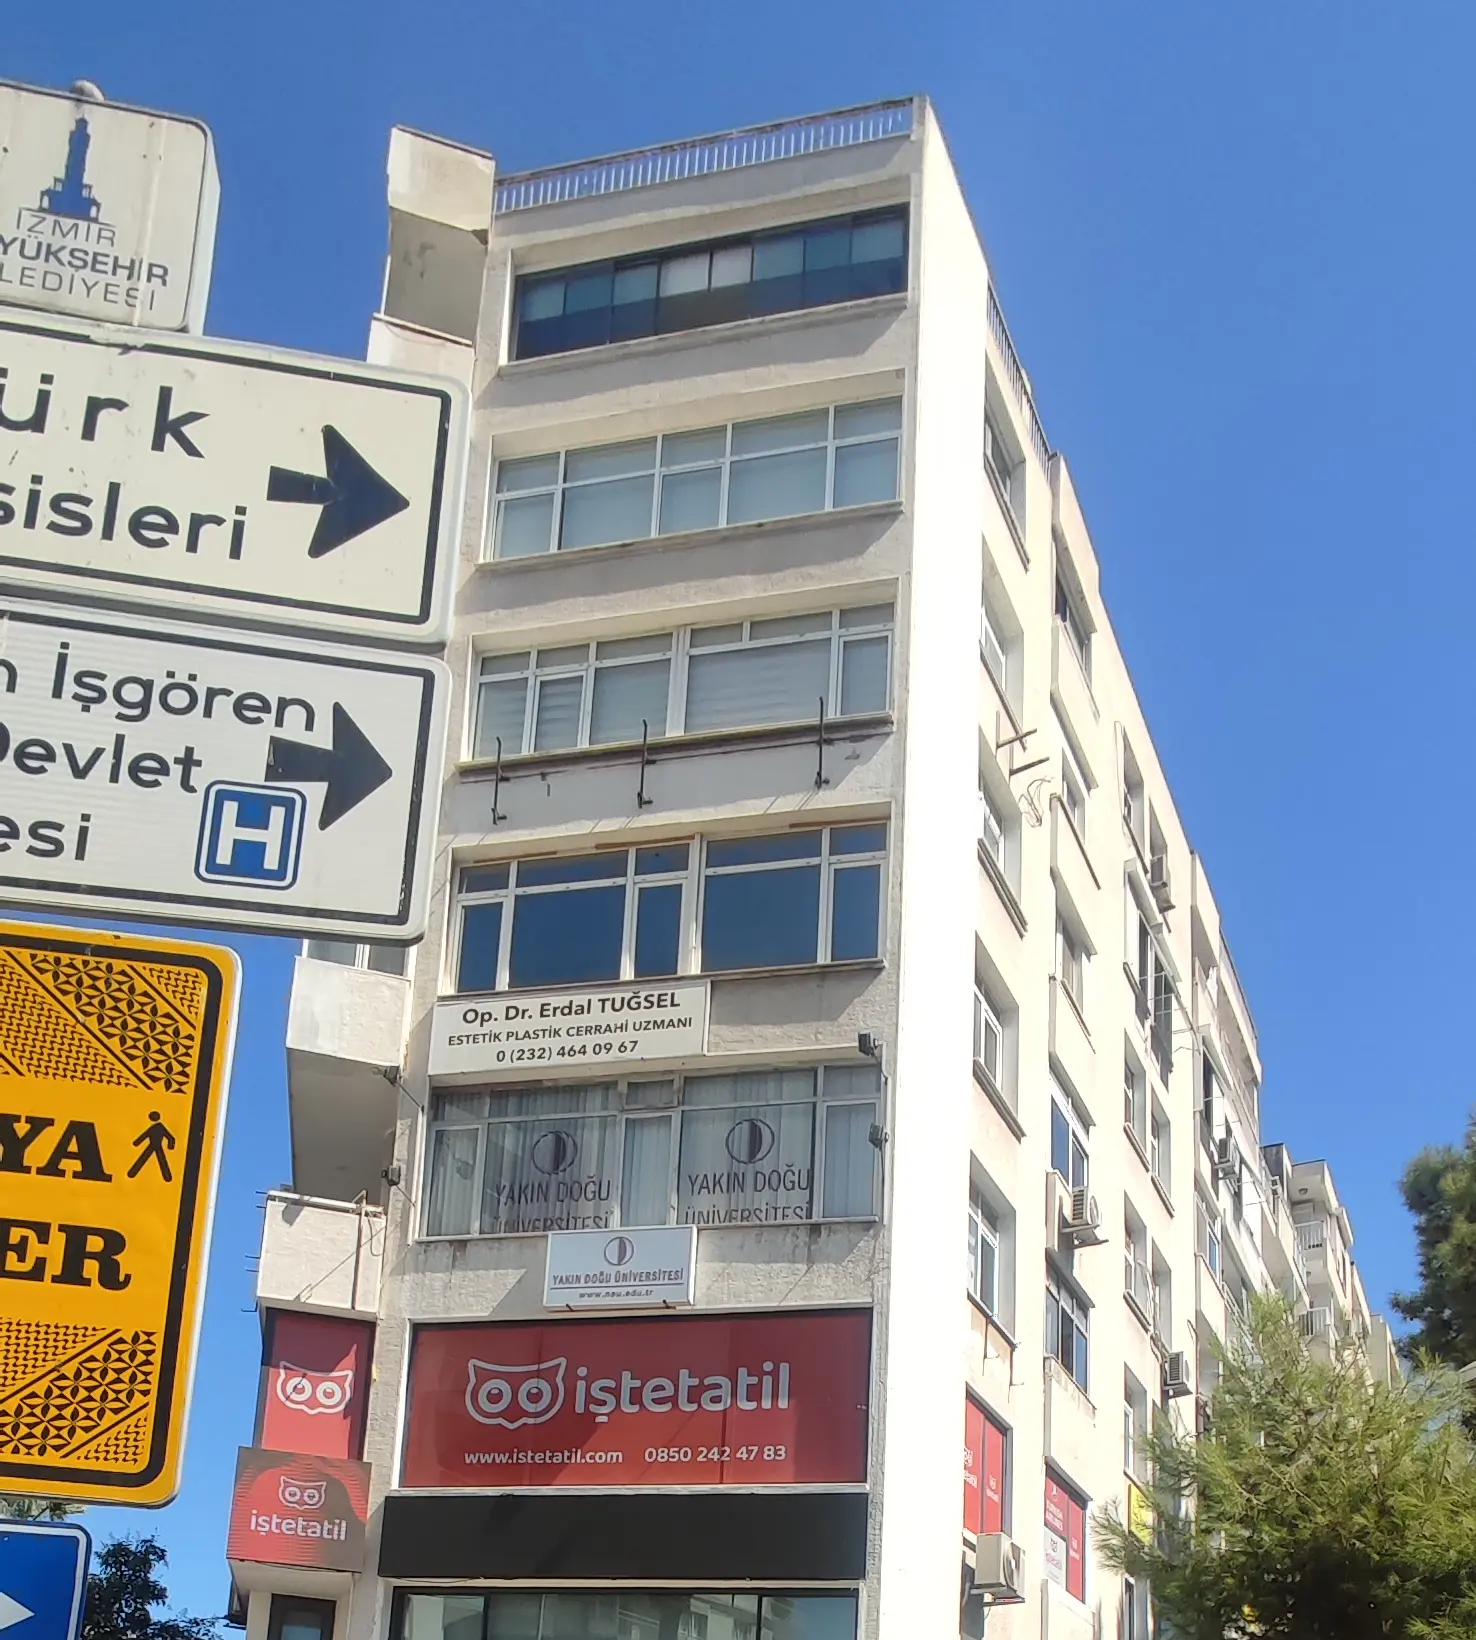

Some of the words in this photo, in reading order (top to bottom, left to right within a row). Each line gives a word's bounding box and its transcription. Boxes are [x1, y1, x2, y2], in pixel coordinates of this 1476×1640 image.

[0, 367, 210, 459] ürk
[52, 641, 316, 732] İşgören
[0, 722, 203, 793] evlet
[462, 1008, 498, 1027] Op.
[504, 1005, 533, 1022] Dr.
[539, 998, 592, 1019] Erdal
[597, 991, 681, 1013] TUĞSEL
[448, 1029, 502, 1046] ESTETİK
[506, 1025, 562, 1043] PLASTİK
[565, 1019, 629, 1038] CERRAHİ
[632, 1017, 693, 1033] UZMANI
[496, 1050, 506, 1063] 0
[510, 1046, 551, 1064] (232)
[556, 1045, 588, 1057] 464
[592, 1042, 613, 1055] 09
[618, 1040, 639, 1053] 67
[0, 1113, 113, 1183] YA
[688, 1171, 746, 1196] YAKIN
[754, 1164, 811, 1193] DOĞU
[0, 1218, 132, 1291] ER
[552, 1274, 581, 1286] YAKIN
[464, 1448, 623, 1465] www.istetatil.com
[644, 1447, 692, 1463] 0850
[696, 1446, 731, 1462] 242
[736, 1445, 759, 1461] 47
[763, 1445, 787, 1461] 83
